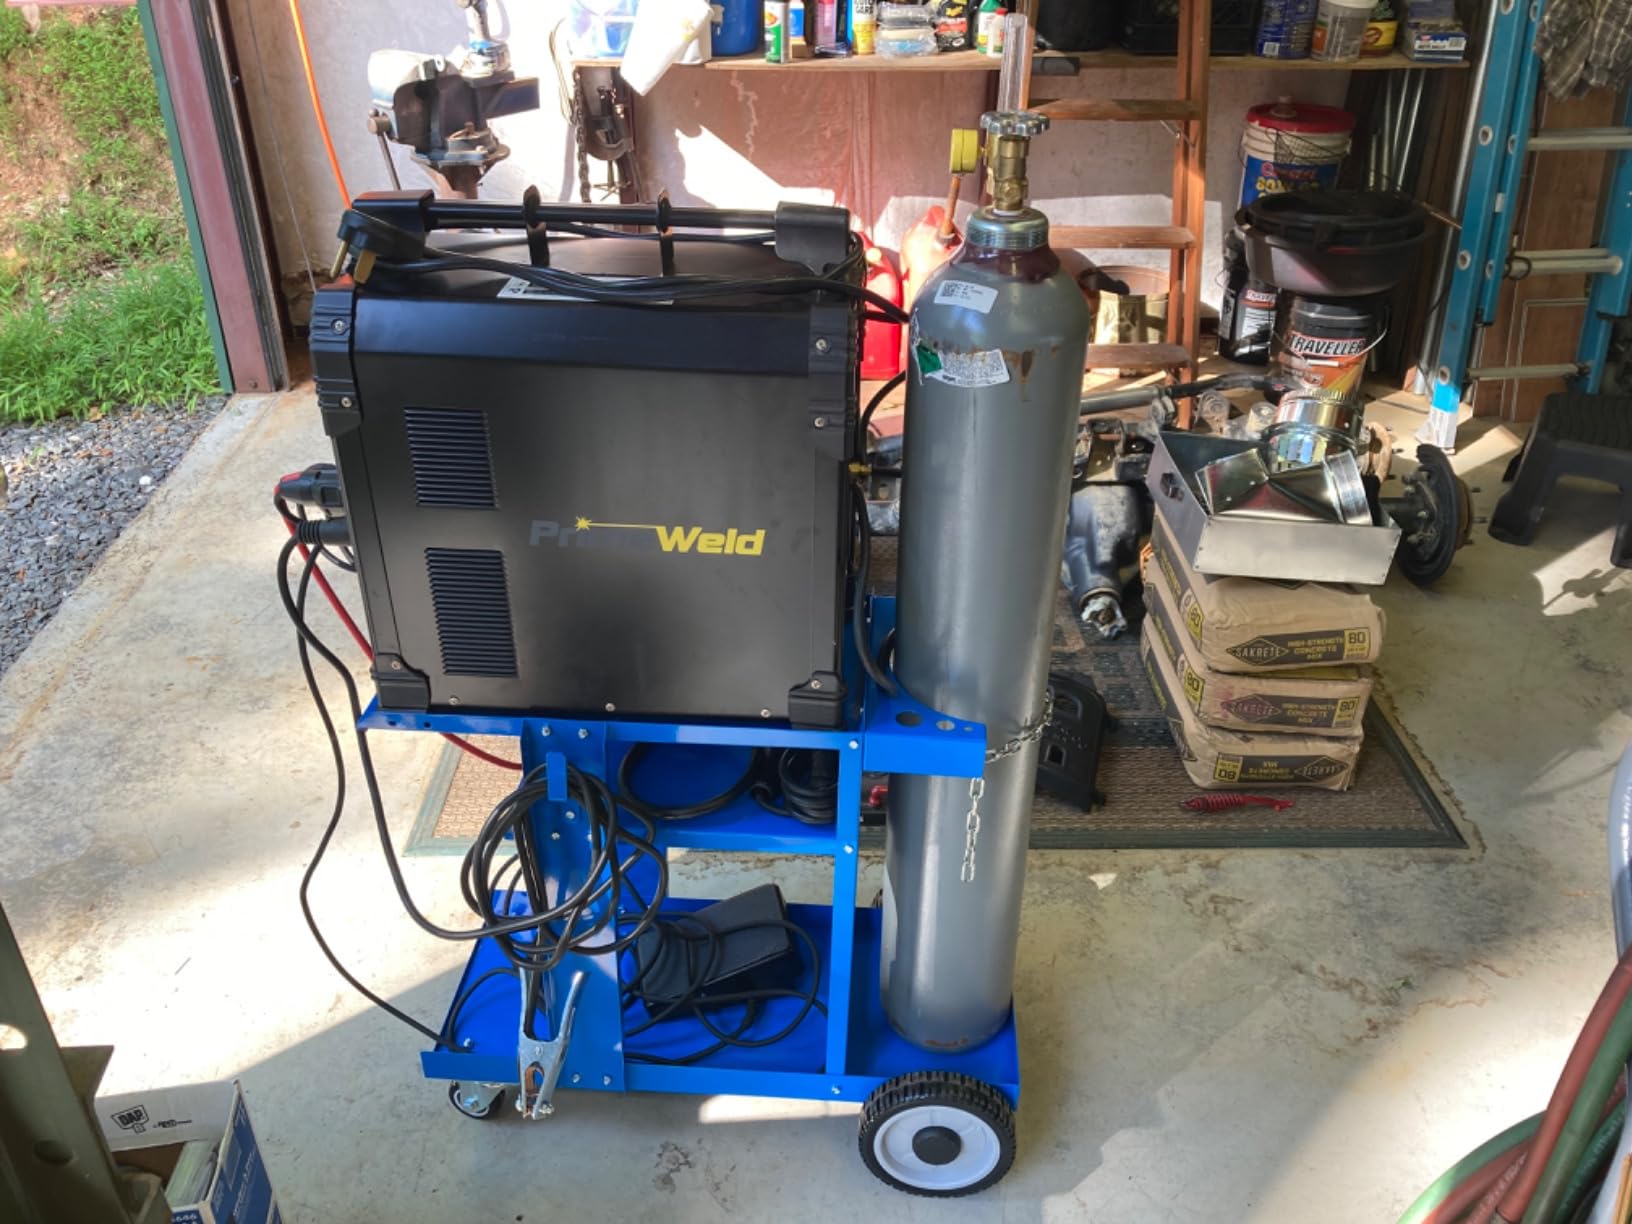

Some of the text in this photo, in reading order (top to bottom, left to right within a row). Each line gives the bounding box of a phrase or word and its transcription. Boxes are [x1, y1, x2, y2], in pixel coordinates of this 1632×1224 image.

[1290, 335, 1366, 355] TRAVELLER
[1348, 632, 1366, 645] 80
[1236, 646, 1281, 657] SAKRETE
[1218, 769, 1236, 780] 80
[118, 1109, 144, 1127] DAP
